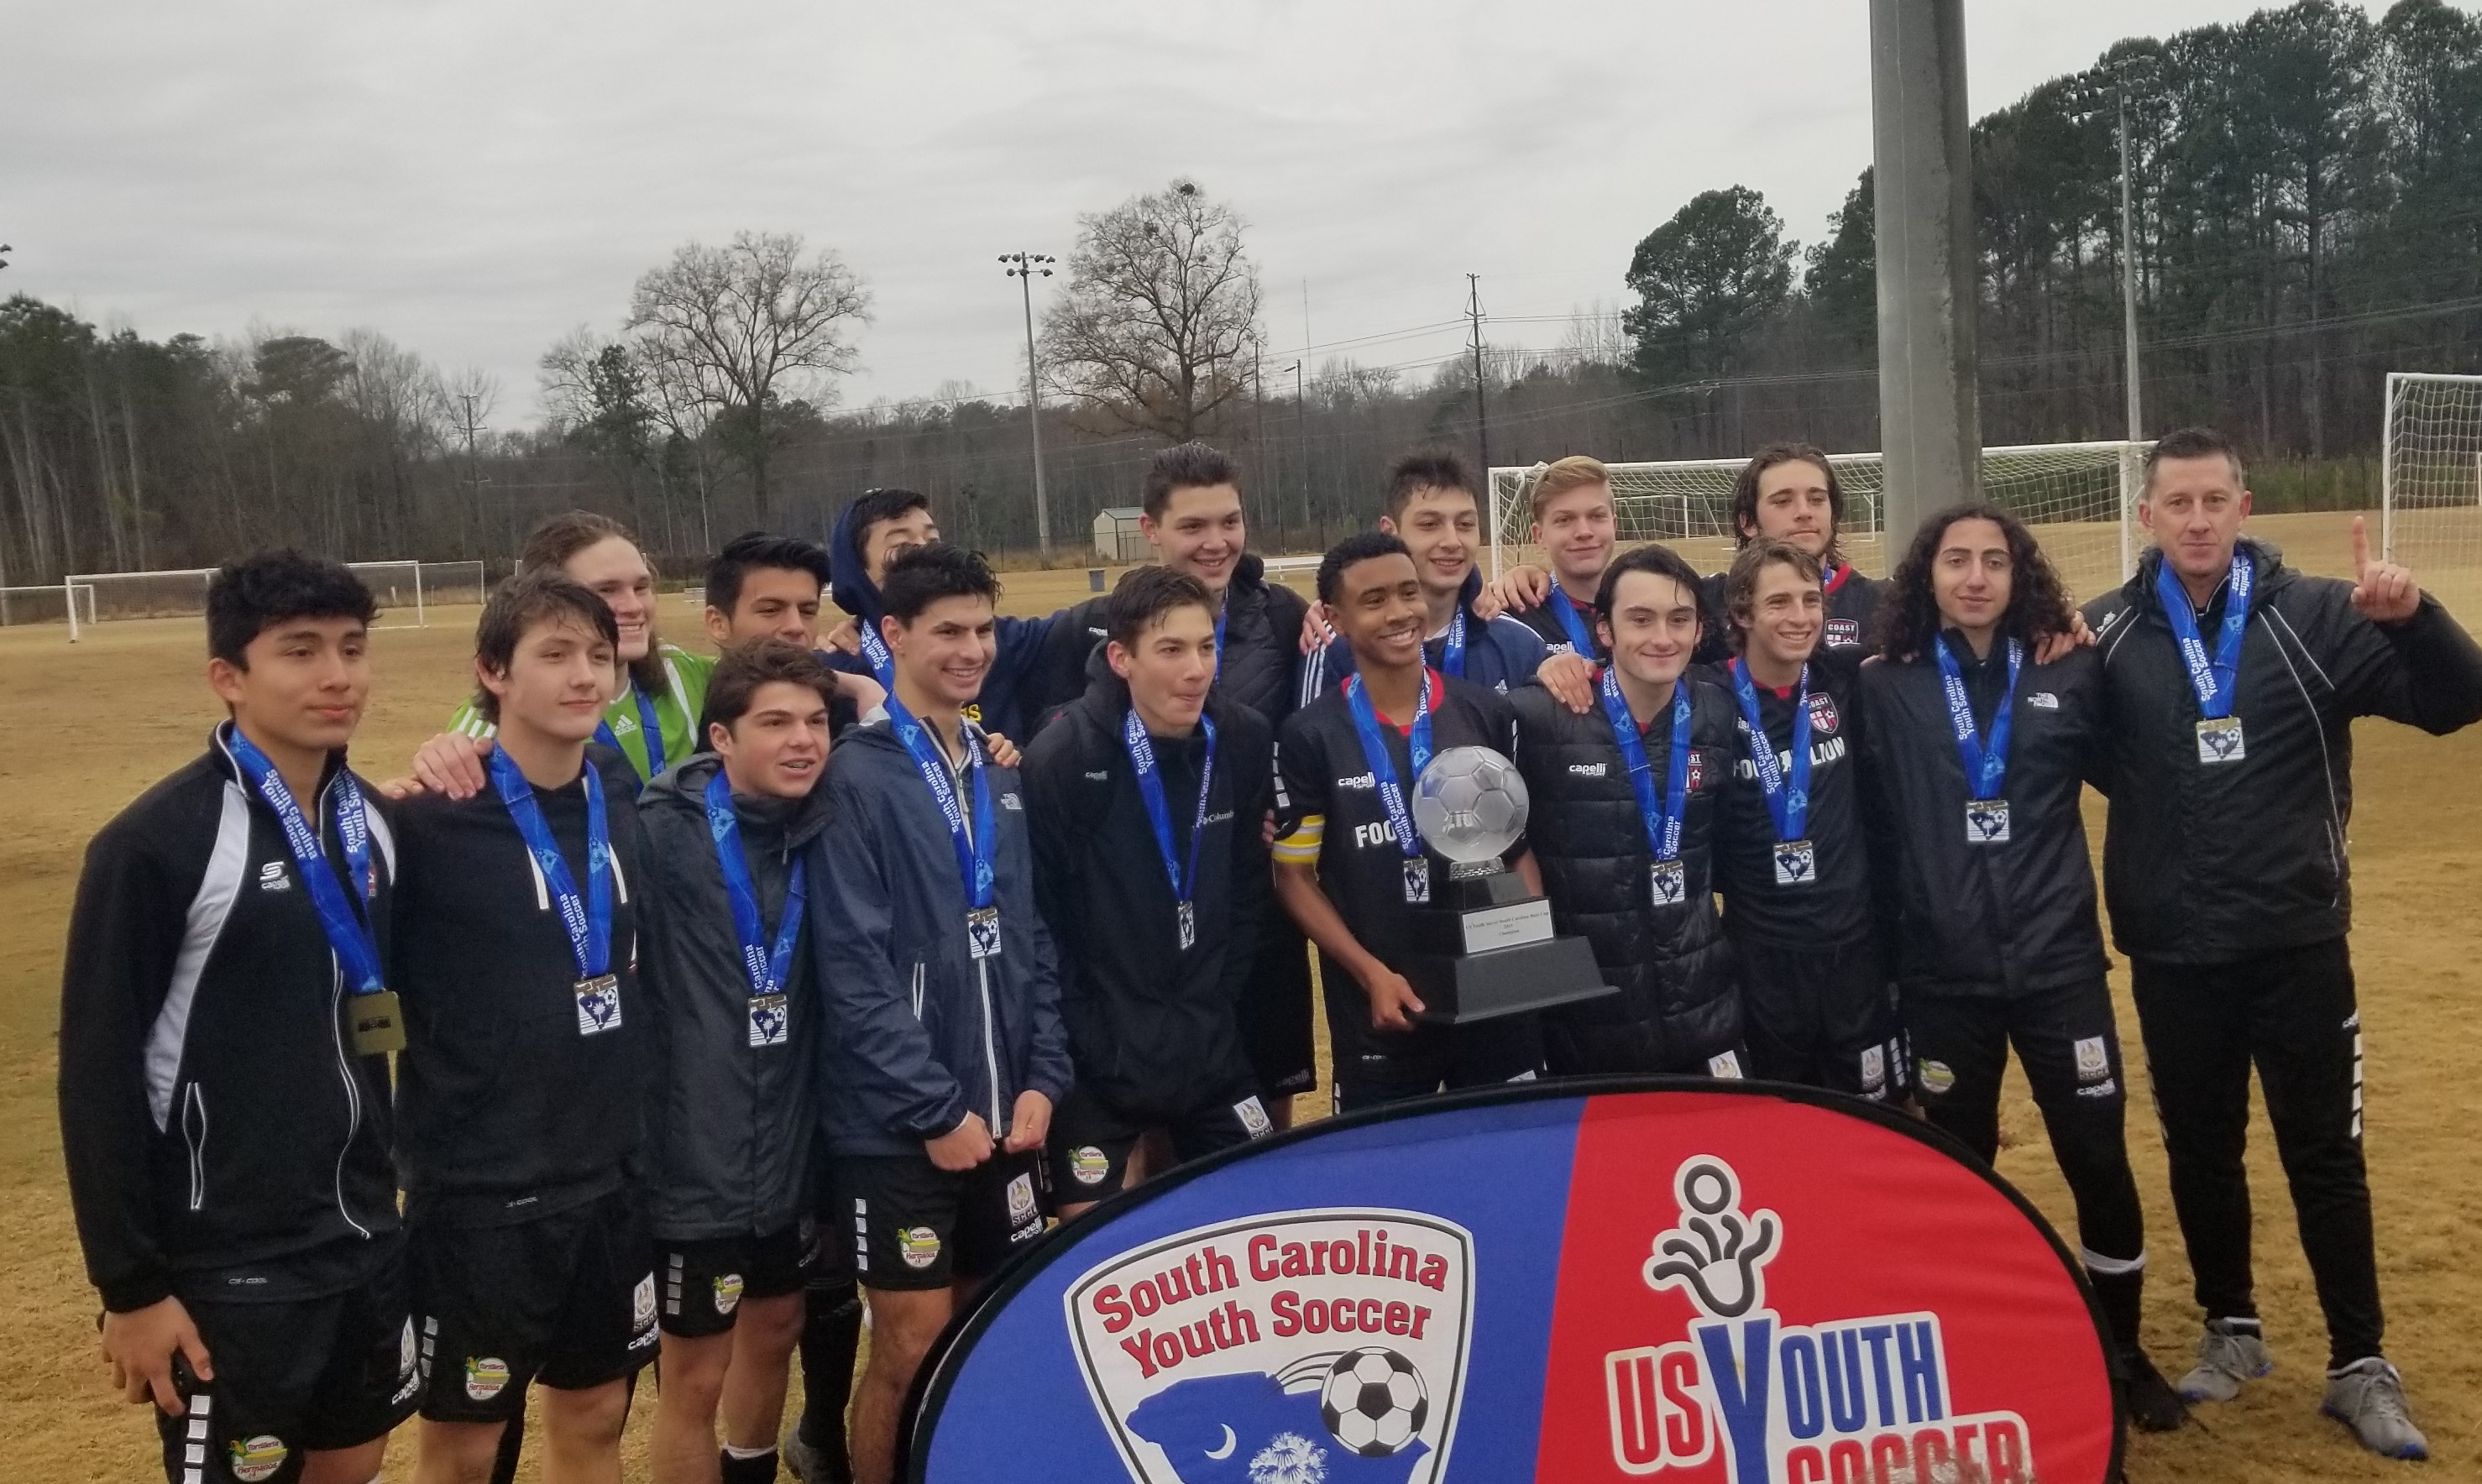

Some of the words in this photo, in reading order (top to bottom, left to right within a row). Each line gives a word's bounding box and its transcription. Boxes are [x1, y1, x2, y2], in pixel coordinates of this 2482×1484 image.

[2239, 566, 2251, 597] Carolina
[1455, 613, 1464, 649] Carolina
[1827, 624, 1856, 632] COAST
[866, 645, 883, 670] South
[872, 635, 889, 662] Youth
[2183, 637, 2201, 674] Carolina
[2192, 639, 2208, 672] Soccer
[1945, 674, 1961, 713] Carolina
[1953, 677, 1967, 708] Soccer
[2195, 672, 2211, 702] South
[2203, 667, 2218, 696] Youth
[1953, 711, 1967, 740] South
[1961, 706, 1975, 736] Youth
[1133, 744, 1148, 775] South
[1140, 737, 1155, 768] Youth
[1751, 729, 1767, 767] Carolina
[1757, 730, 1773, 760] Soccer
[1810, 736, 1846, 766] LION
[921, 761, 946, 803] Carolina
[930, 760, 951, 796] Soccer
[1568, 762, 1607, 774] capelli
[1761, 766, 1776, 795] South
[1768, 760, 1782, 788] Youth
[266, 769, 291, 807] South
[289, 806, 317, 860] Carolina
[947, 794, 963, 827] Youth
[1380, 781, 1400, 822] Carolina
[1390, 783, 1406, 816] Soccer
[261, 778, 287, 815] Youth
[282, 818, 306, 860] Soccer
[352, 809, 368, 848] Youth
[942, 801, 959, 833] South
[1401, 815, 1413, 848] Youth
[339, 816, 358, 854] South
[1395, 819, 1409, 850] South
[1663, 815, 1675, 855] Carolina
[1671, 821, 1680, 853] Soccer
[559, 893, 581, 943] Carolina
[570, 894, 589, 933] Soccer
[745, 944, 763, 990] Carolina
[1092, 1246, 1239, 1335] South
[1248, 1230, 1449, 1293] Carolina
[1121, 1300, 1260, 1379] Youth
[1270, 1289, 1432, 1341] Soccer
[1615, 1351, 1704, 1465] US
